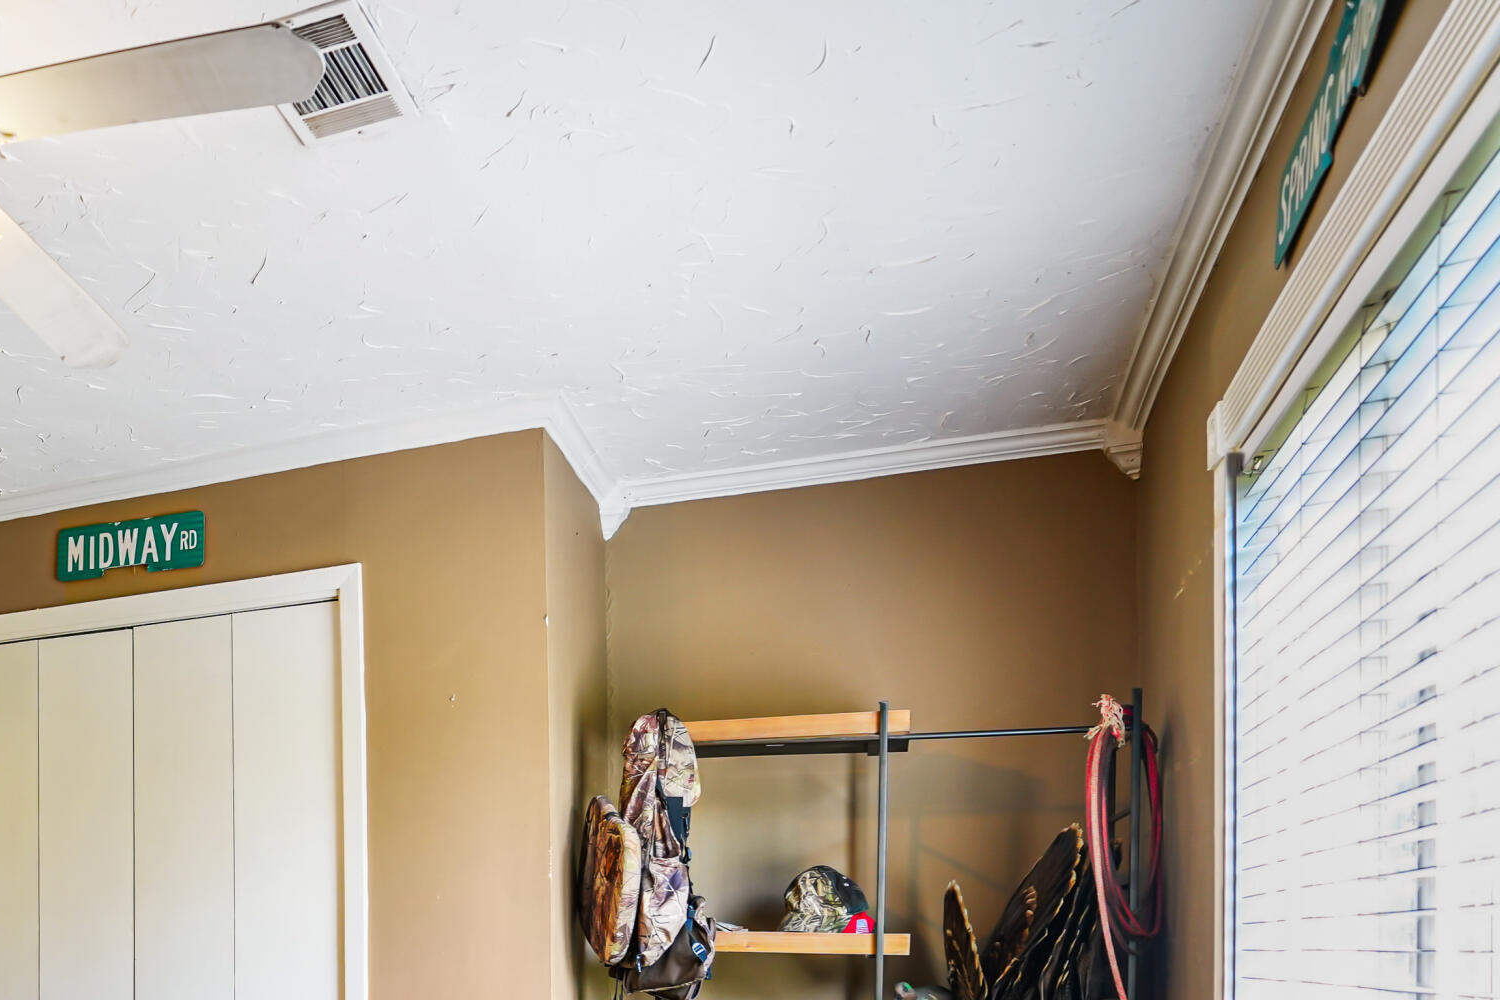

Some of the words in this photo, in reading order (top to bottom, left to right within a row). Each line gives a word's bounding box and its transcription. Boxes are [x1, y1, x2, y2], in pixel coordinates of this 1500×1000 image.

[1278, 73, 1335, 246] SPRING
[67, 522, 179, 573] MIDWAY
[179, 529, 198, 551] RD
